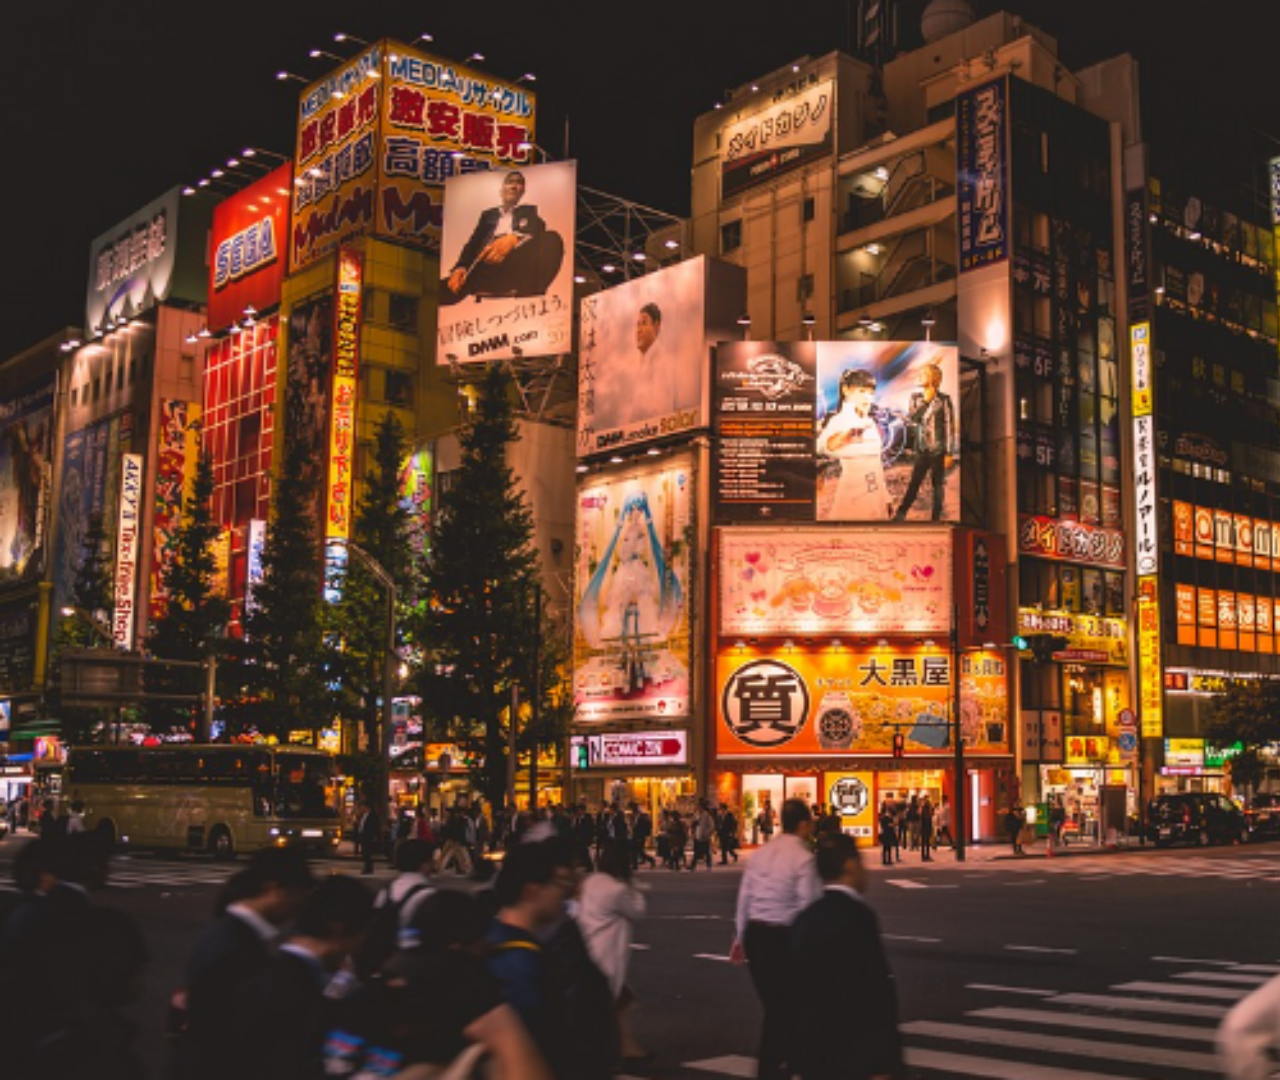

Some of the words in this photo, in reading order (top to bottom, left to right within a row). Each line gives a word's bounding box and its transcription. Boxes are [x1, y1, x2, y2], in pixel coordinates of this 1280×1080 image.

[390, 85, 530, 162] 激安販売
[214, 216, 274, 287] SEGA
[734, 672, 798, 740] 質
[858, 658, 950, 687] 大黒屋
